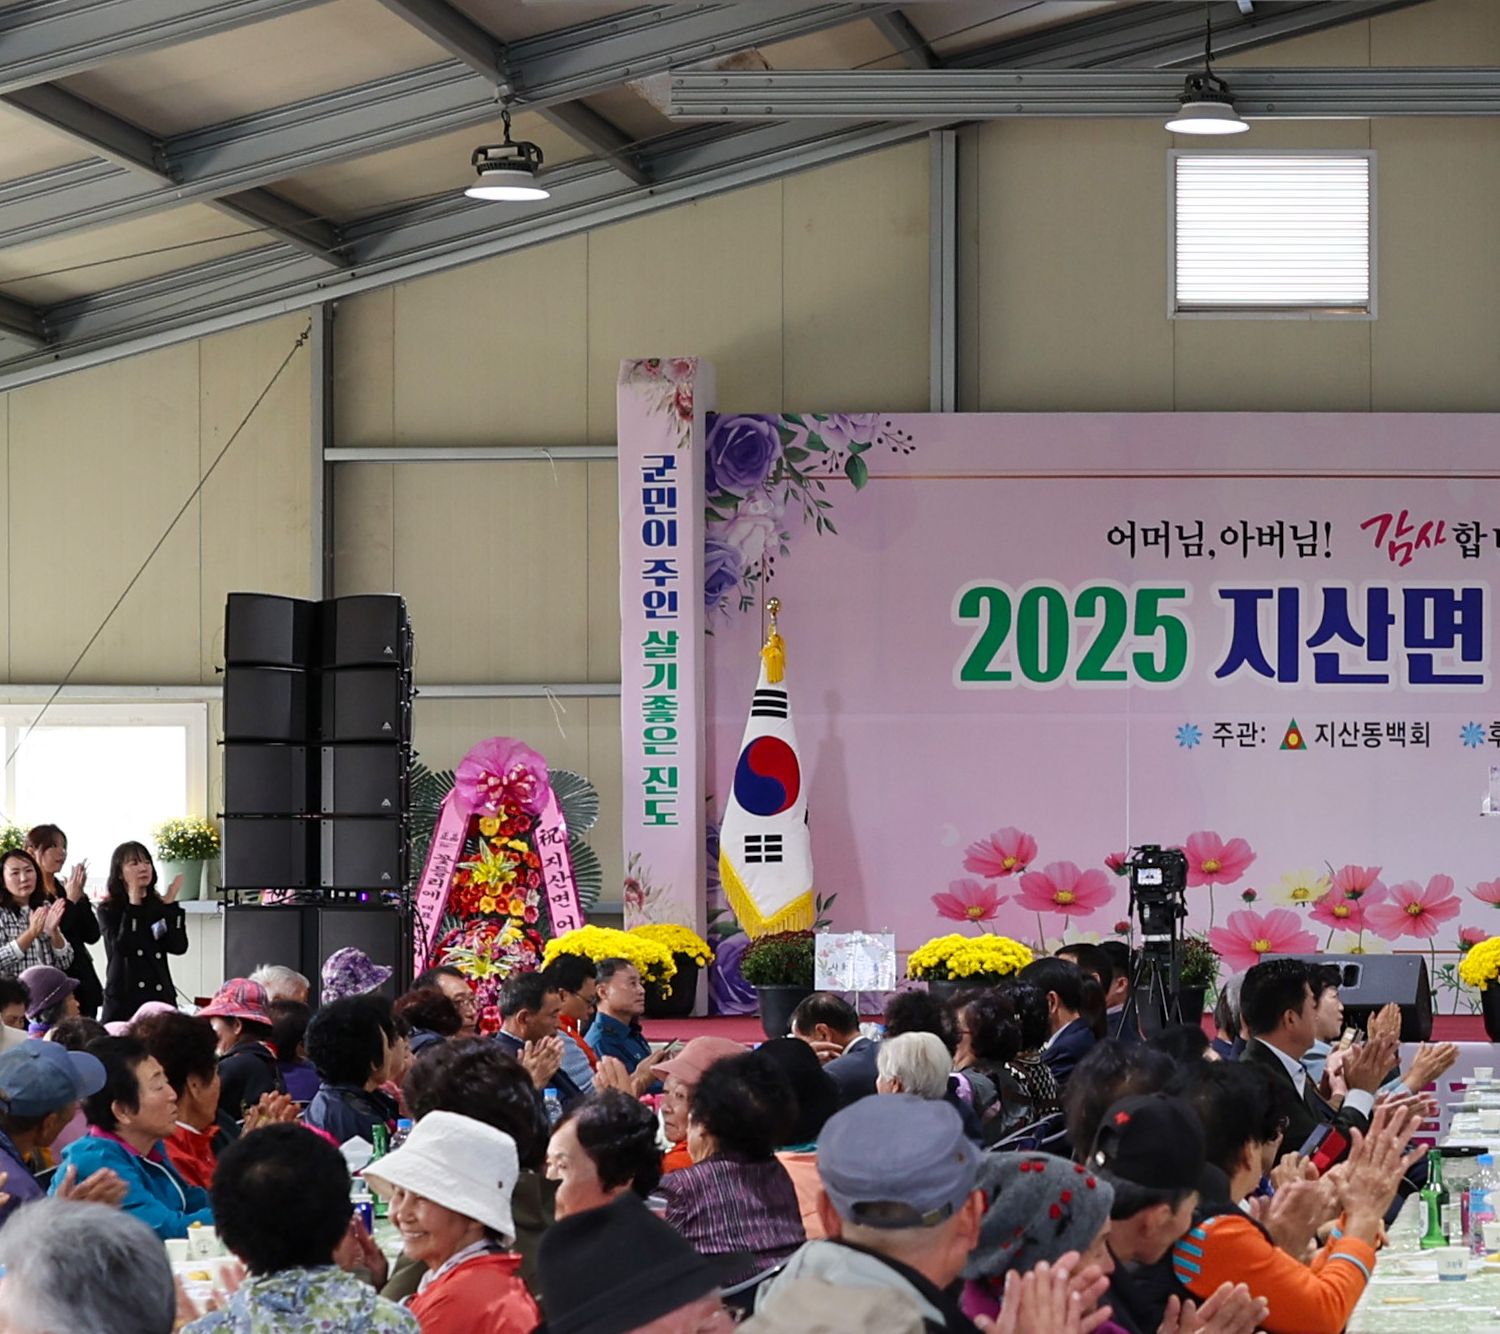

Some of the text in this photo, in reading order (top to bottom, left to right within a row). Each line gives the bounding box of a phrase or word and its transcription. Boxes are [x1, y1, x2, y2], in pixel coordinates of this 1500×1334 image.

[640, 454, 680, 826] 군민이 주인 살기좋은 진도
[957, 585, 1188, 683] 2025
[1214, 586, 1484, 685] 지산면
[1212, 720, 1430, 749] 주관: 지산동백회
[538, 827, 563, 847] 祝
[544, 853, 573, 907] 지산면
